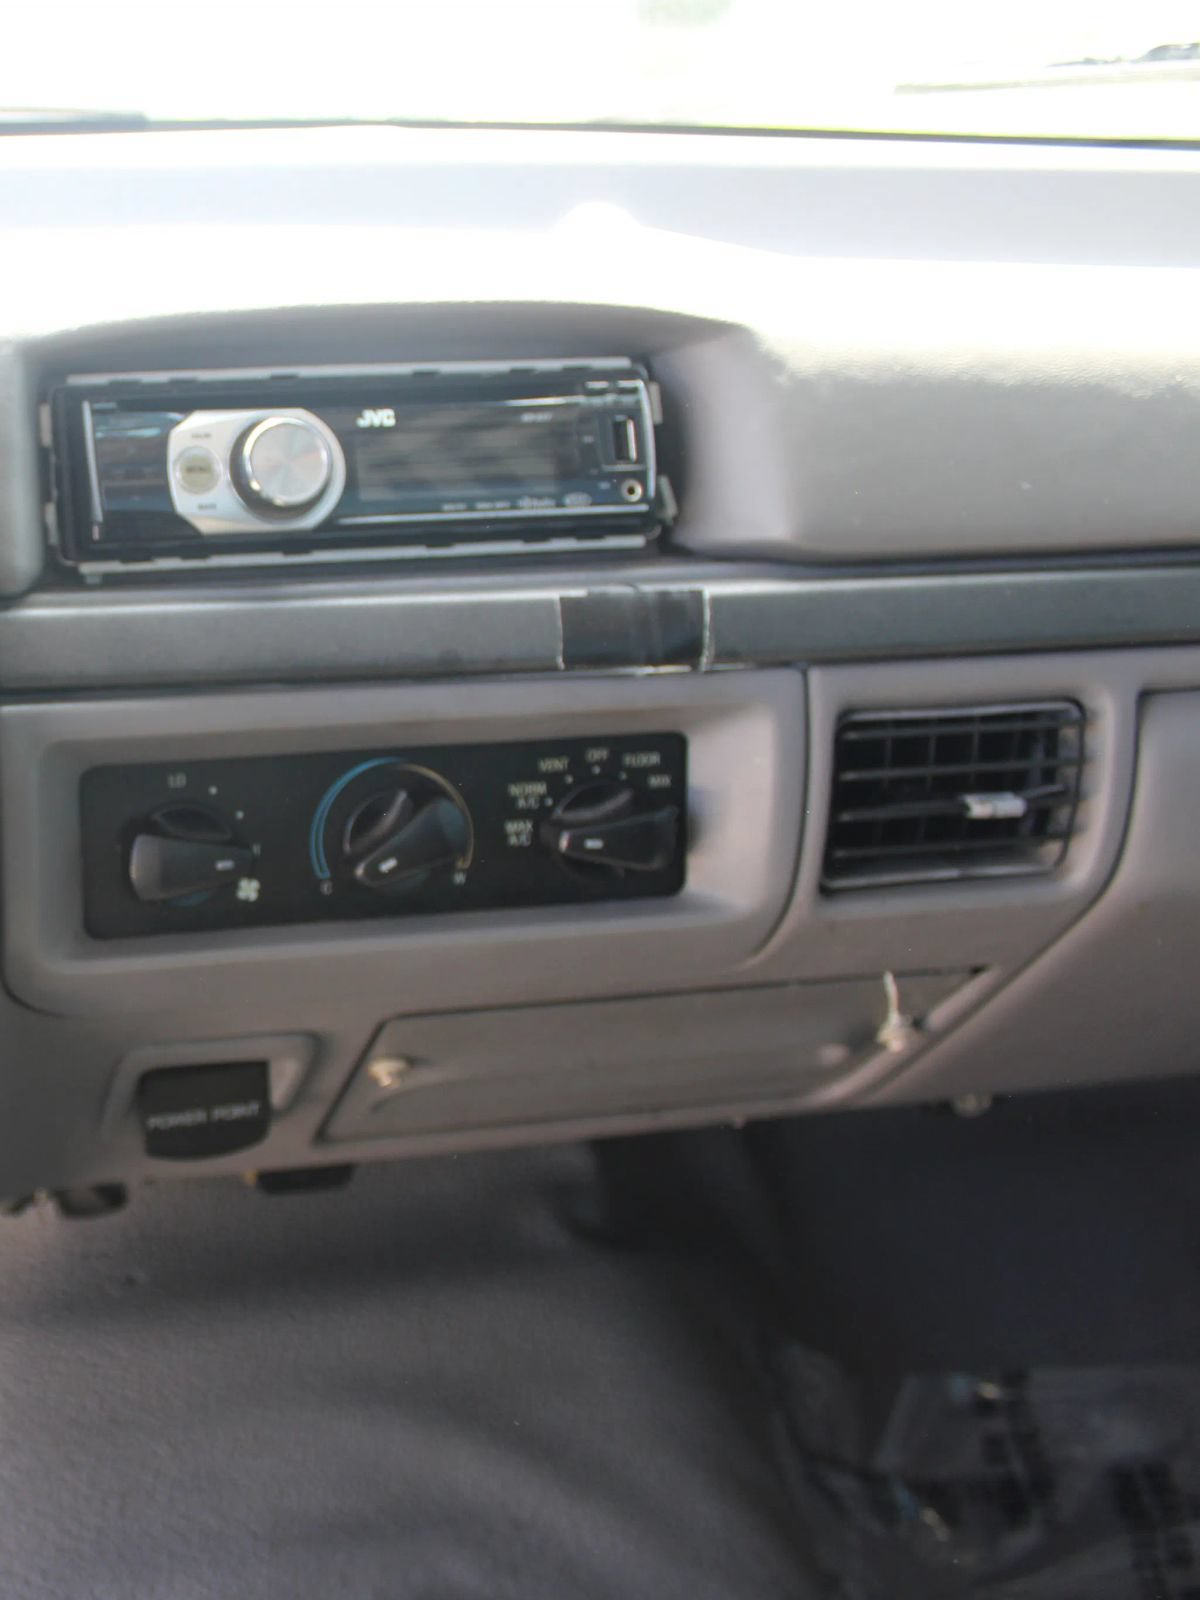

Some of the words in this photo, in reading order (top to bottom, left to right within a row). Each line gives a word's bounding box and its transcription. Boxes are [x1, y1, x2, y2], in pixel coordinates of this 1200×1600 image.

[356, 408, 396, 428] JVC
[587, 749, 609, 762] OFF
[624, 753, 660, 768] FLOOR
[539, 757, 569, 773] VENT
[168, 773, 187, 788] LO
[507, 781, 547, 797] NORM
[516, 796, 540, 809] A/C
[505, 820, 533, 834] MAX
[507, 833, 532, 848] A/C
[146, 1108, 208, 1132] POWER
[211, 1101, 260, 1122] POINT
